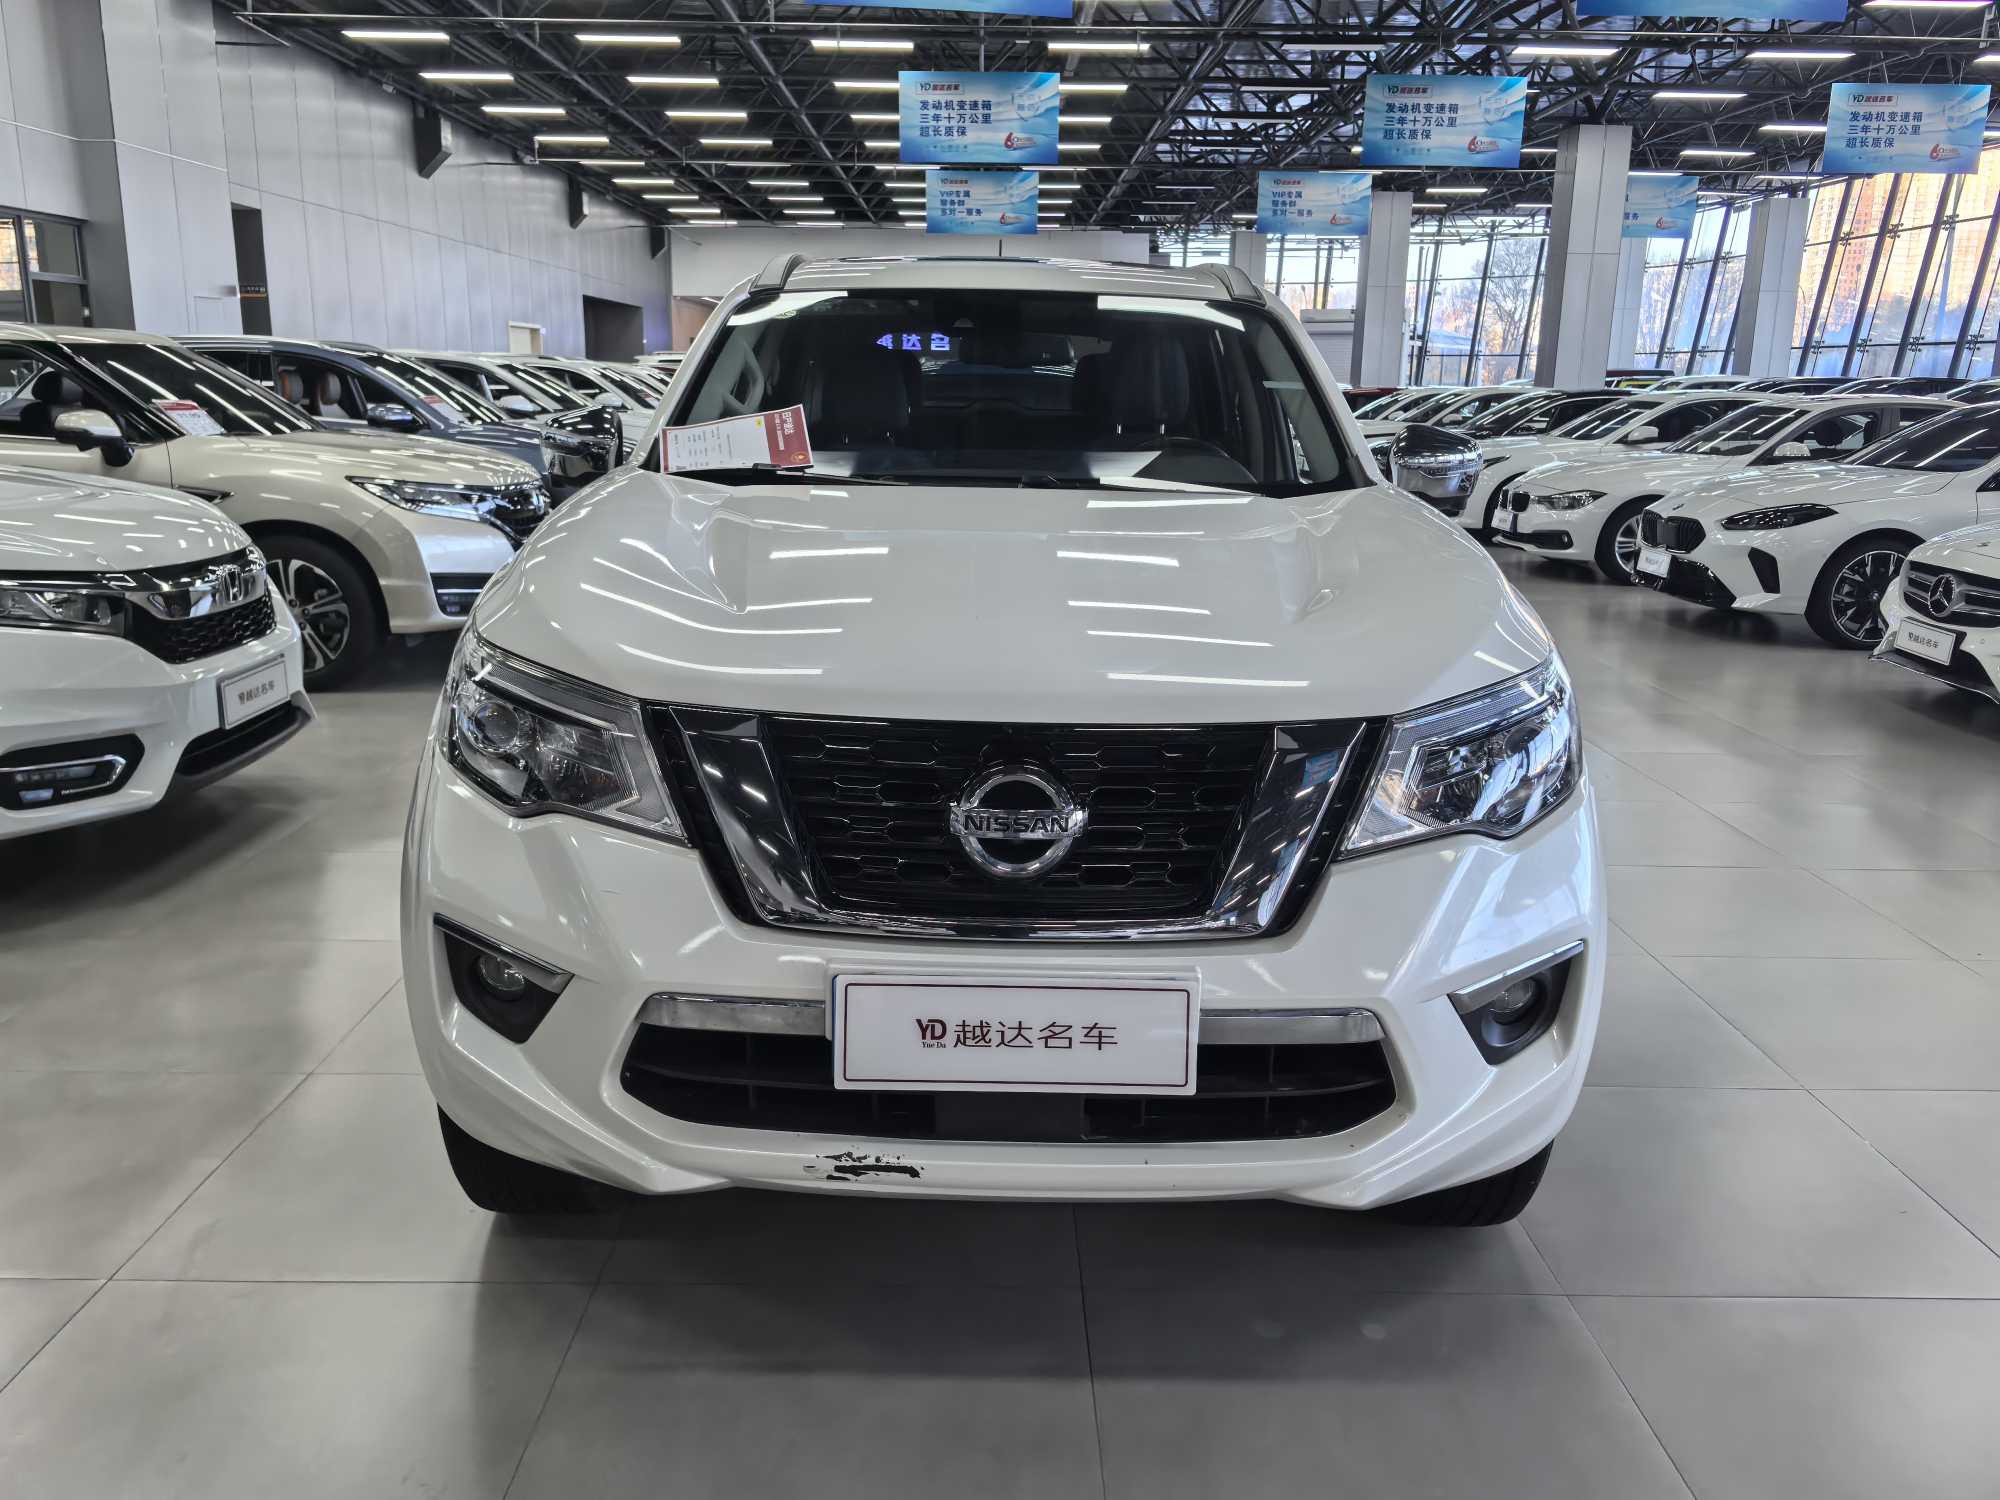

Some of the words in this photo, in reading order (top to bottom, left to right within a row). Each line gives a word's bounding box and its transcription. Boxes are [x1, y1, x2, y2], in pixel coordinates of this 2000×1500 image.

[919, 100, 992, 111] 发动机变速箱
[1385, 103, 1459, 114] 发动机变速箱
[919, 113, 992, 124] 三年十万公里
[1384, 116, 1457, 127] 三年十万公里
[1849, 111, 1923, 123] 发动机变速箱
[919, 126, 967, 137] 超长质保
[1383, 129, 1432, 140] 超长质保
[1847, 125, 1921, 136] 三年十万公里
[1845, 137, 1895, 149] 超长质保
[963, 814, 1070, 833] NISSAN
[915, 1018, 947, 1041] YD
[953, 1019, 1118, 1051] 越达名车
